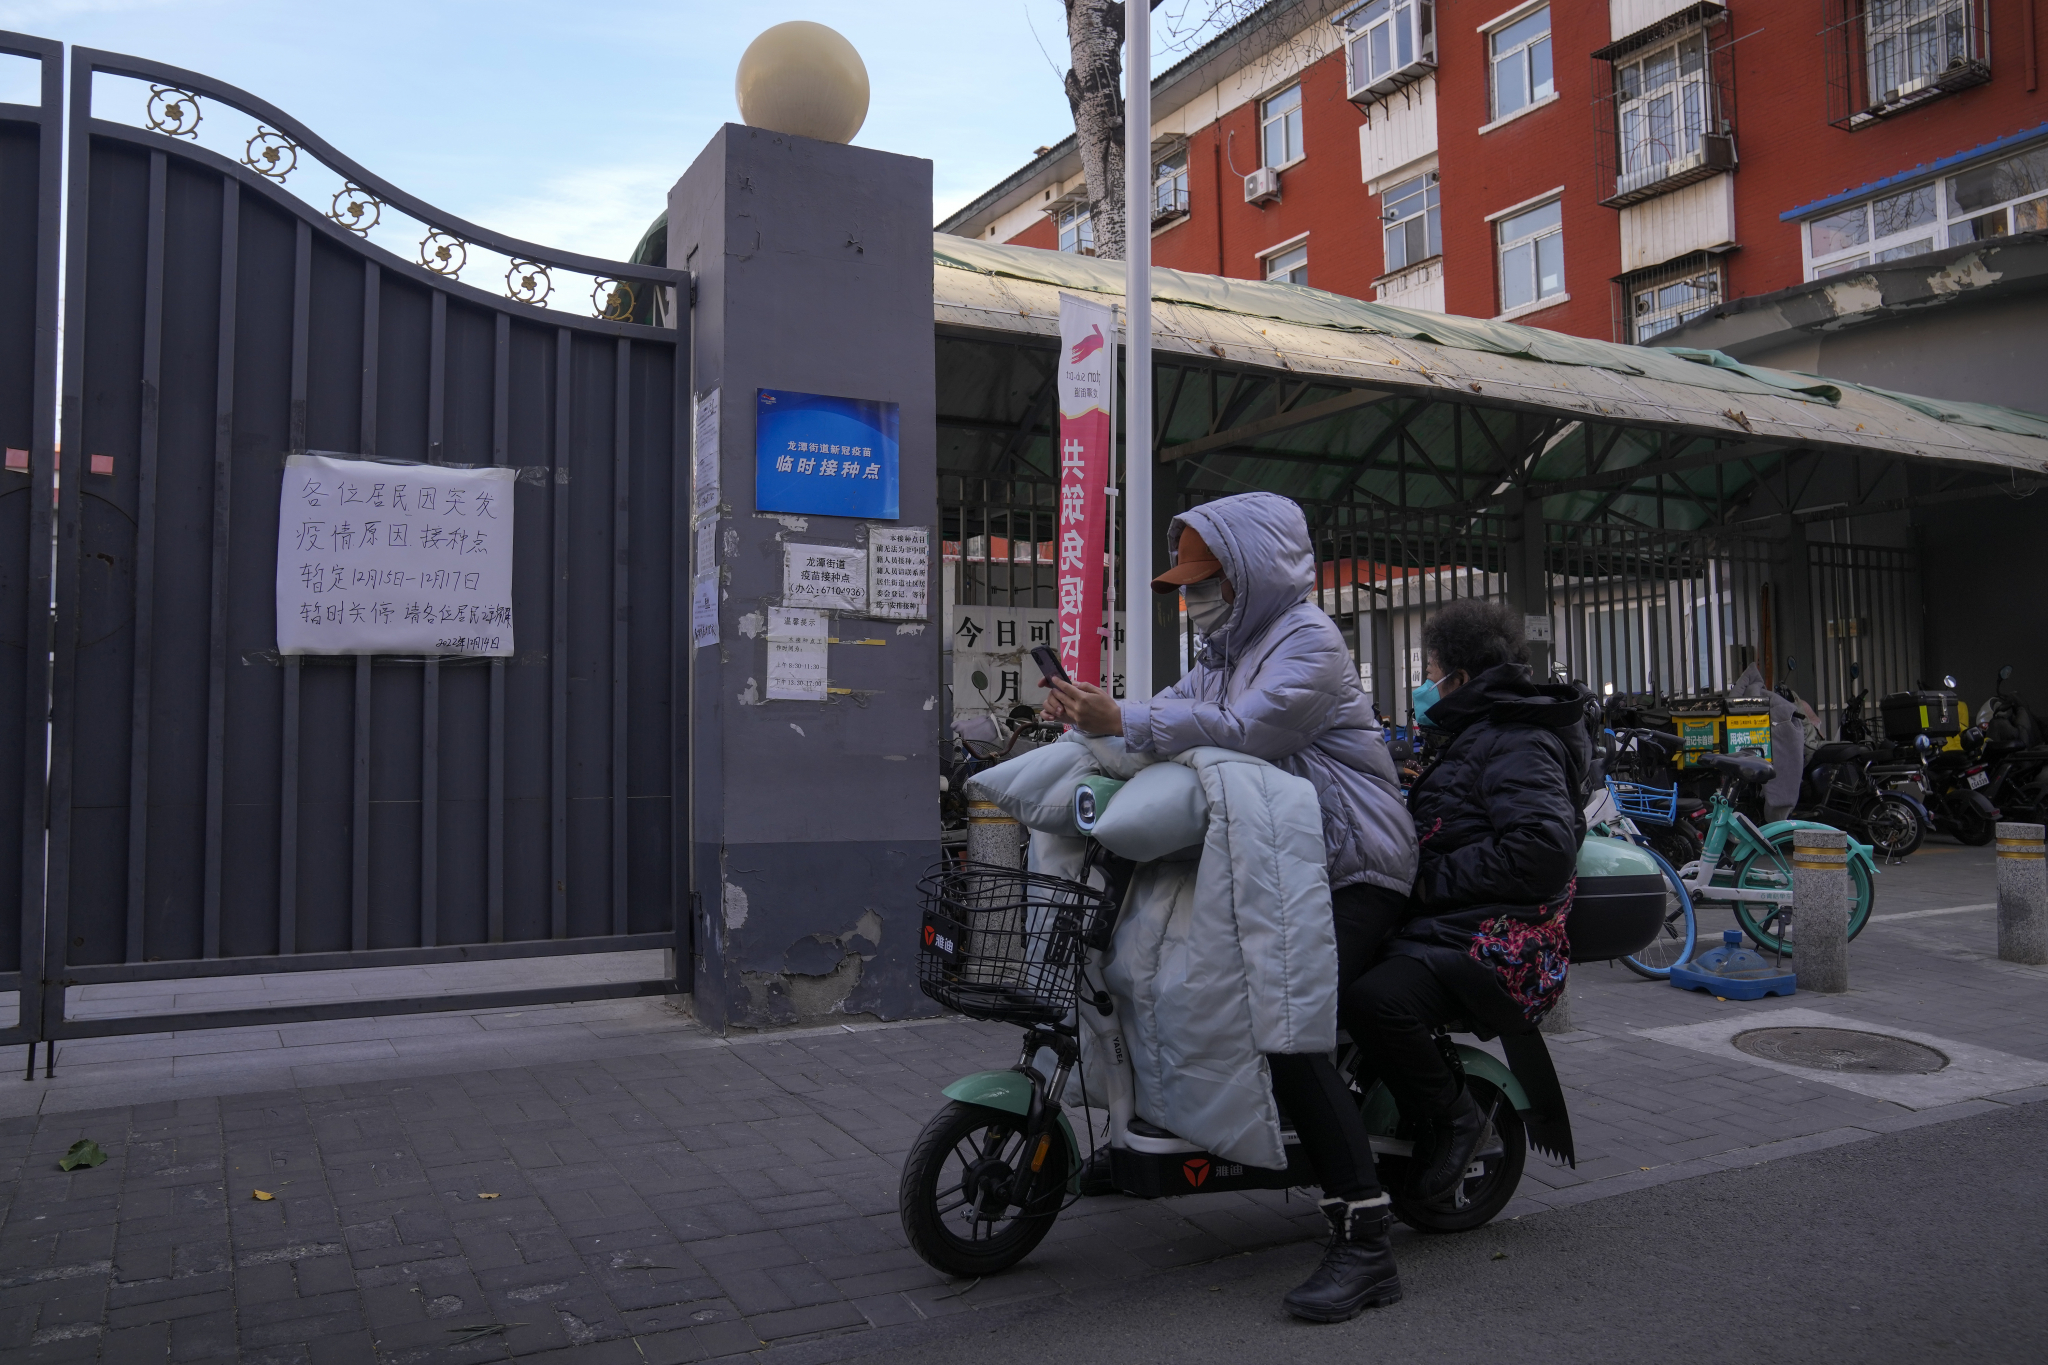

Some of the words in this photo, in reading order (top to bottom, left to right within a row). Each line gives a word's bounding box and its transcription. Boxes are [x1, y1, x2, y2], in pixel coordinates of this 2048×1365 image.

[787, 440, 873, 458] 龙潭街道新冠疫苗
[776, 454, 881, 480] 临时接种点
[806, 556, 846, 570] 龙潭街道
[800, 570, 851, 583] 疫苗接种点
[783, 616, 816, 627] 温馨提示
[935, 935, 954, 954] 雅迪
[1113, 1036, 1124, 1064] YADEA
[1215, 1163, 1244, 1178] 雅迪
